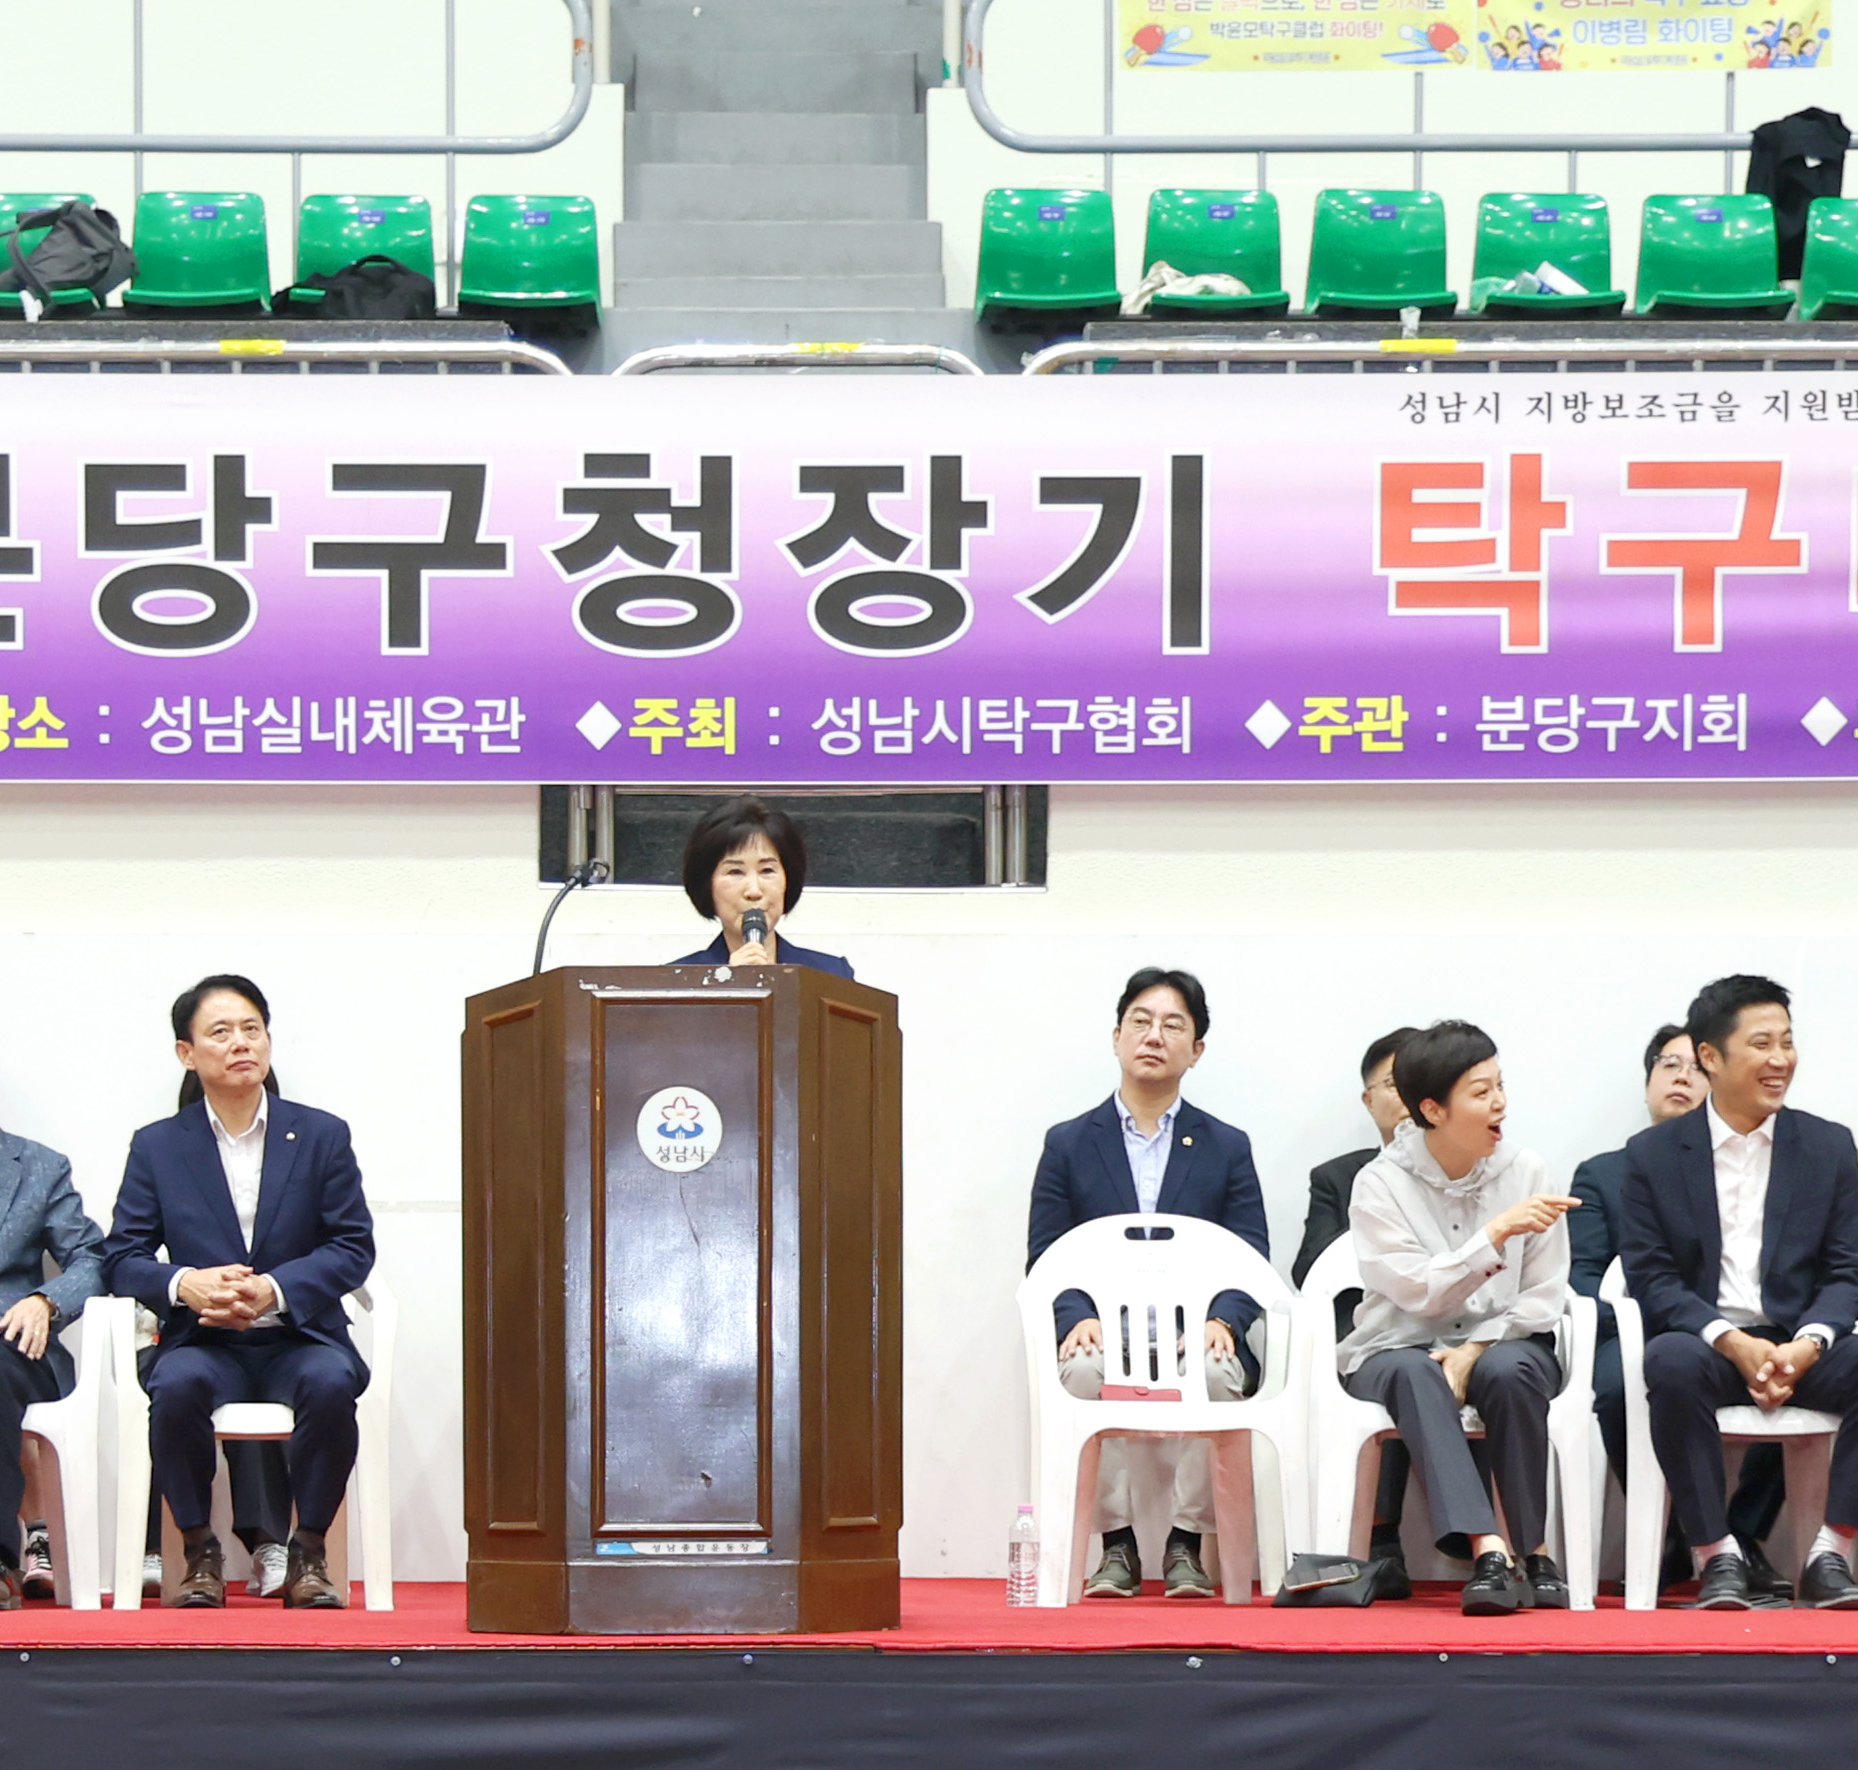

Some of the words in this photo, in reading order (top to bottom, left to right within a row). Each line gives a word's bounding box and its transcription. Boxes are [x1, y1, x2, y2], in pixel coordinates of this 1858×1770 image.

[1572, 18, 1648, 45] 이병림
[1658, 17, 1734, 44] 화이팅
[1398, 390, 1501, 424] 성남시
[1526, 390, 1742, 424] 지방보조금을
[140, 695, 527, 756] 성남실내체육관
[628, 695, 738, 755] 주최
[810, 694, 1193, 756] 성남시탁구협회
[1298, 694, 1410, 753] 주관
[1474, 693, 1750, 754] 분당구지회
[656, 1145, 705, 1164] 성남시
